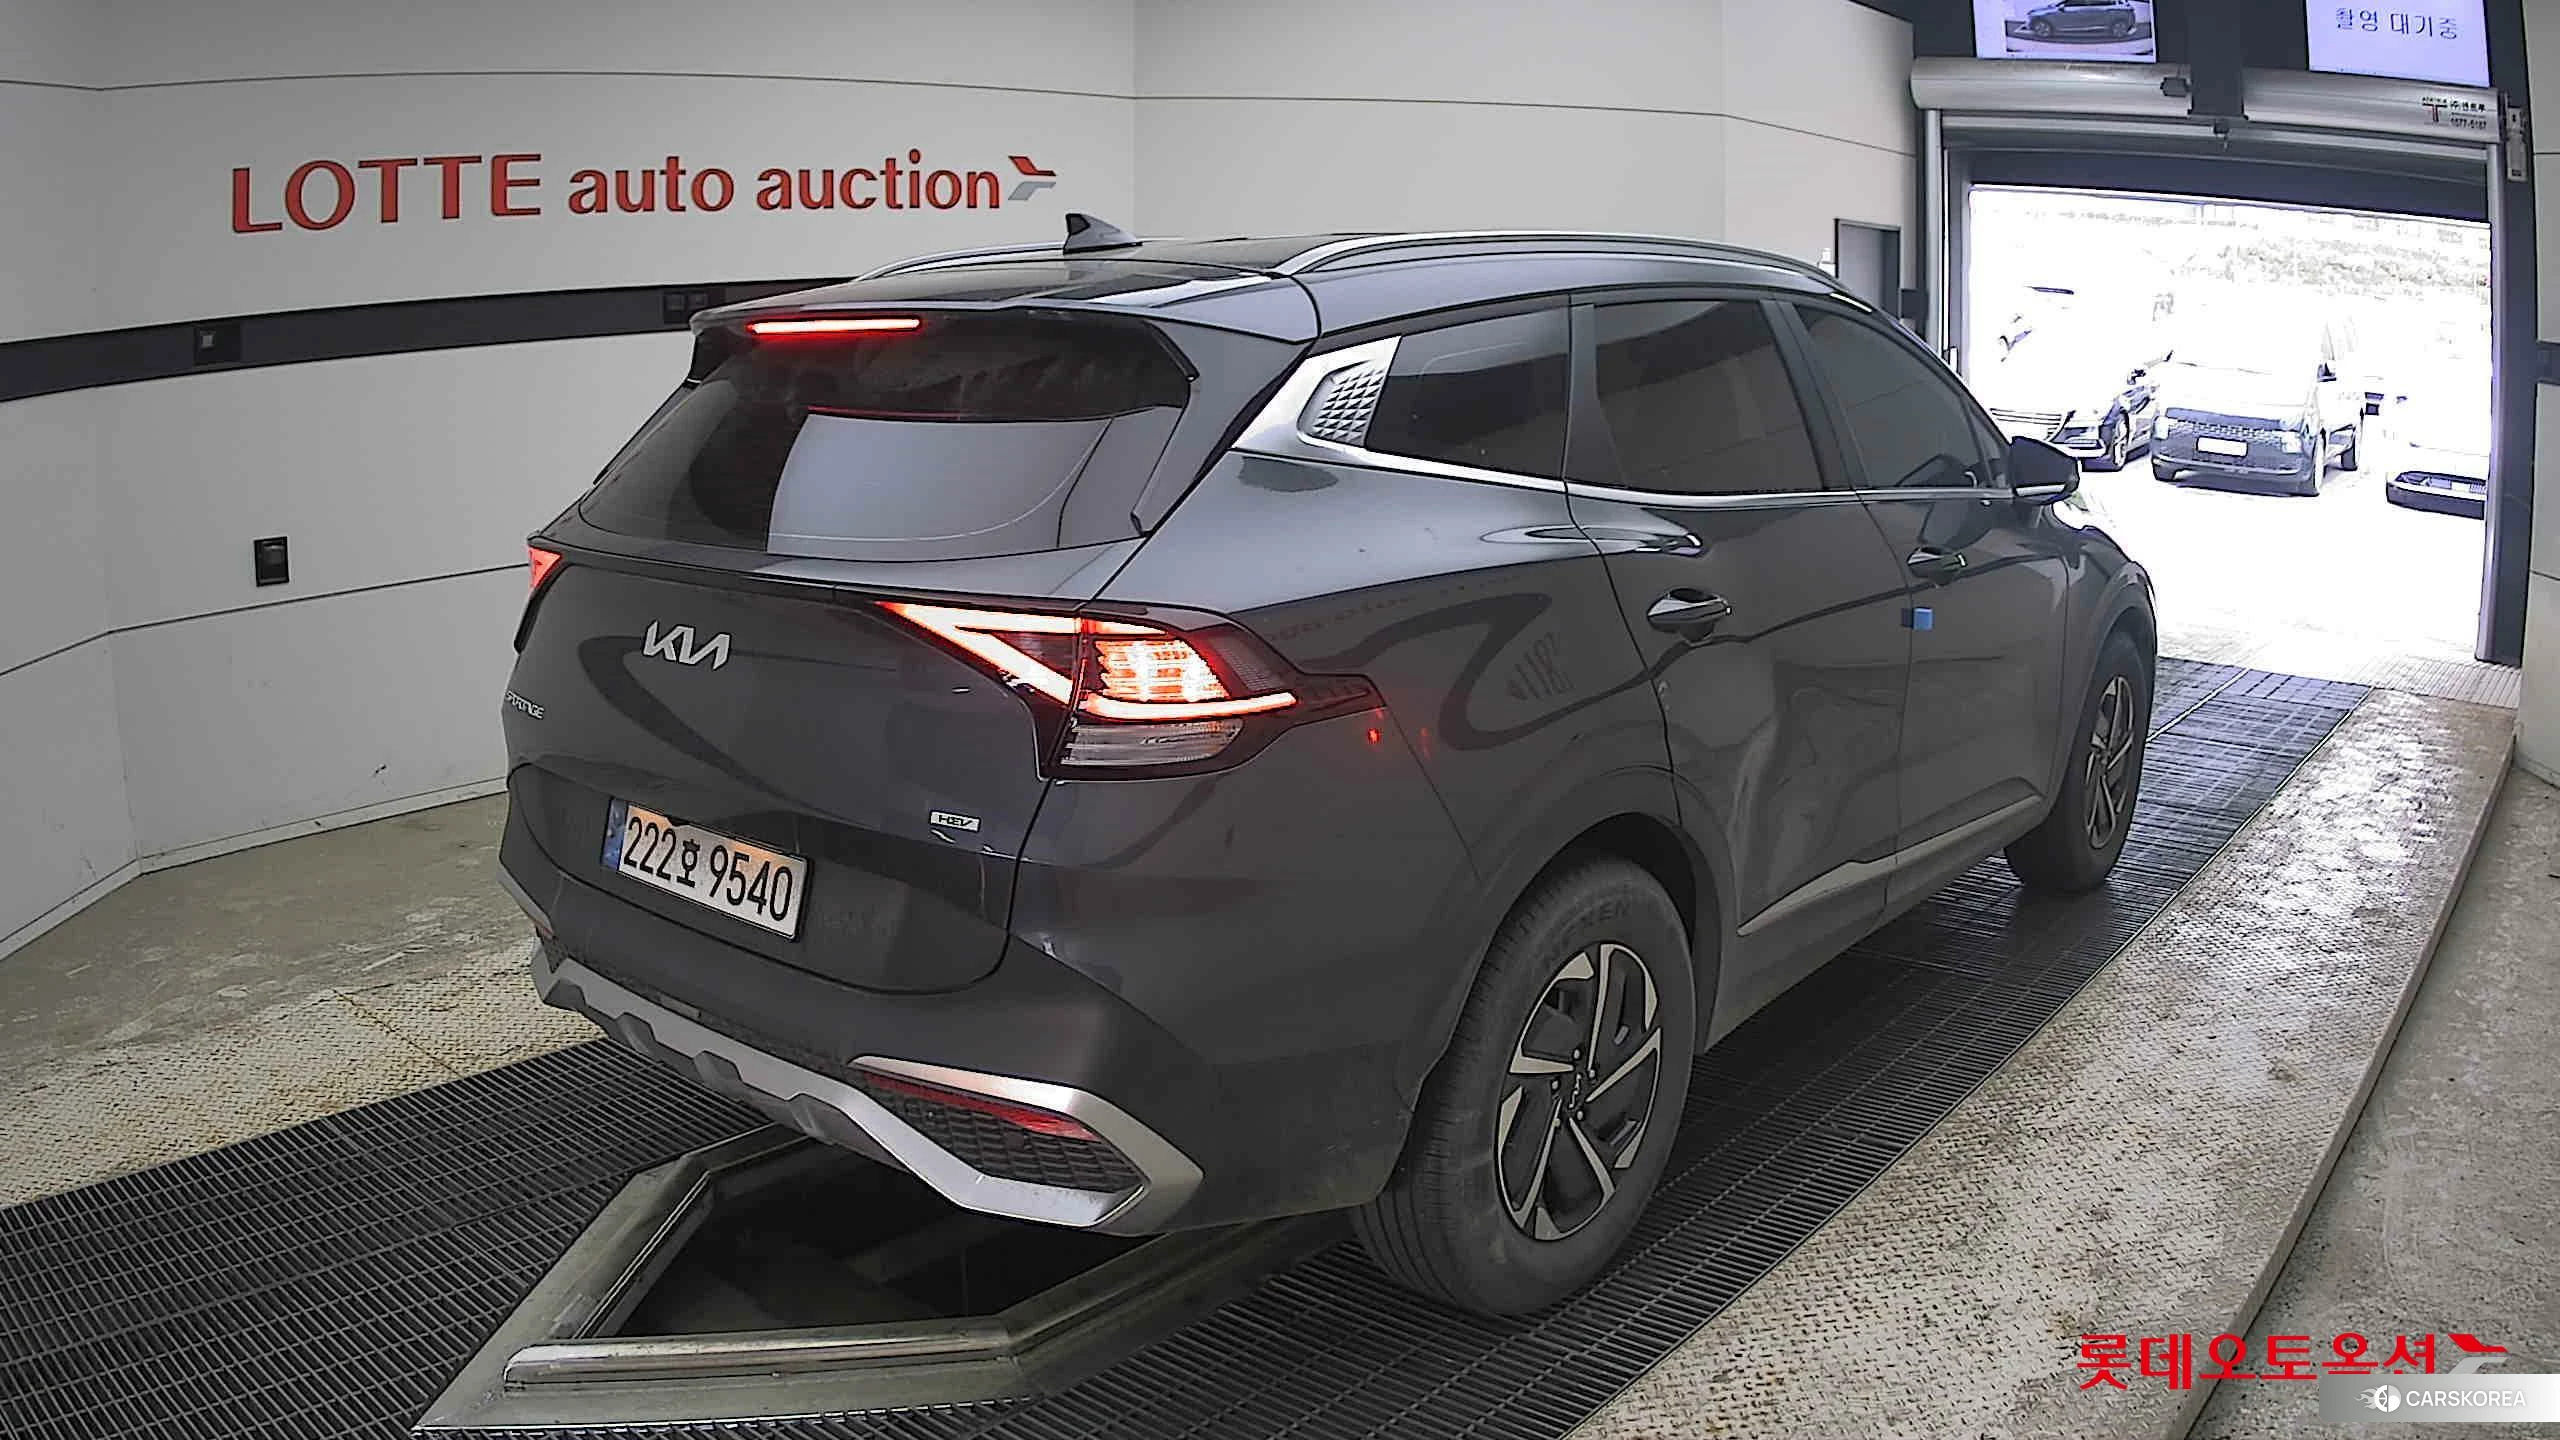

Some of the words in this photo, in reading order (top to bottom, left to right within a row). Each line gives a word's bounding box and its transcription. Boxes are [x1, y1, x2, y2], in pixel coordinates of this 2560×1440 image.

[231, 152, 542, 234] LOTTE
[568, 155, 734, 214] auto
[755, 150, 1001, 211] auction
[641, 619, 732, 669] KIA
[623, 816, 701, 888] 222호
[709, 844, 793, 921] 9540
